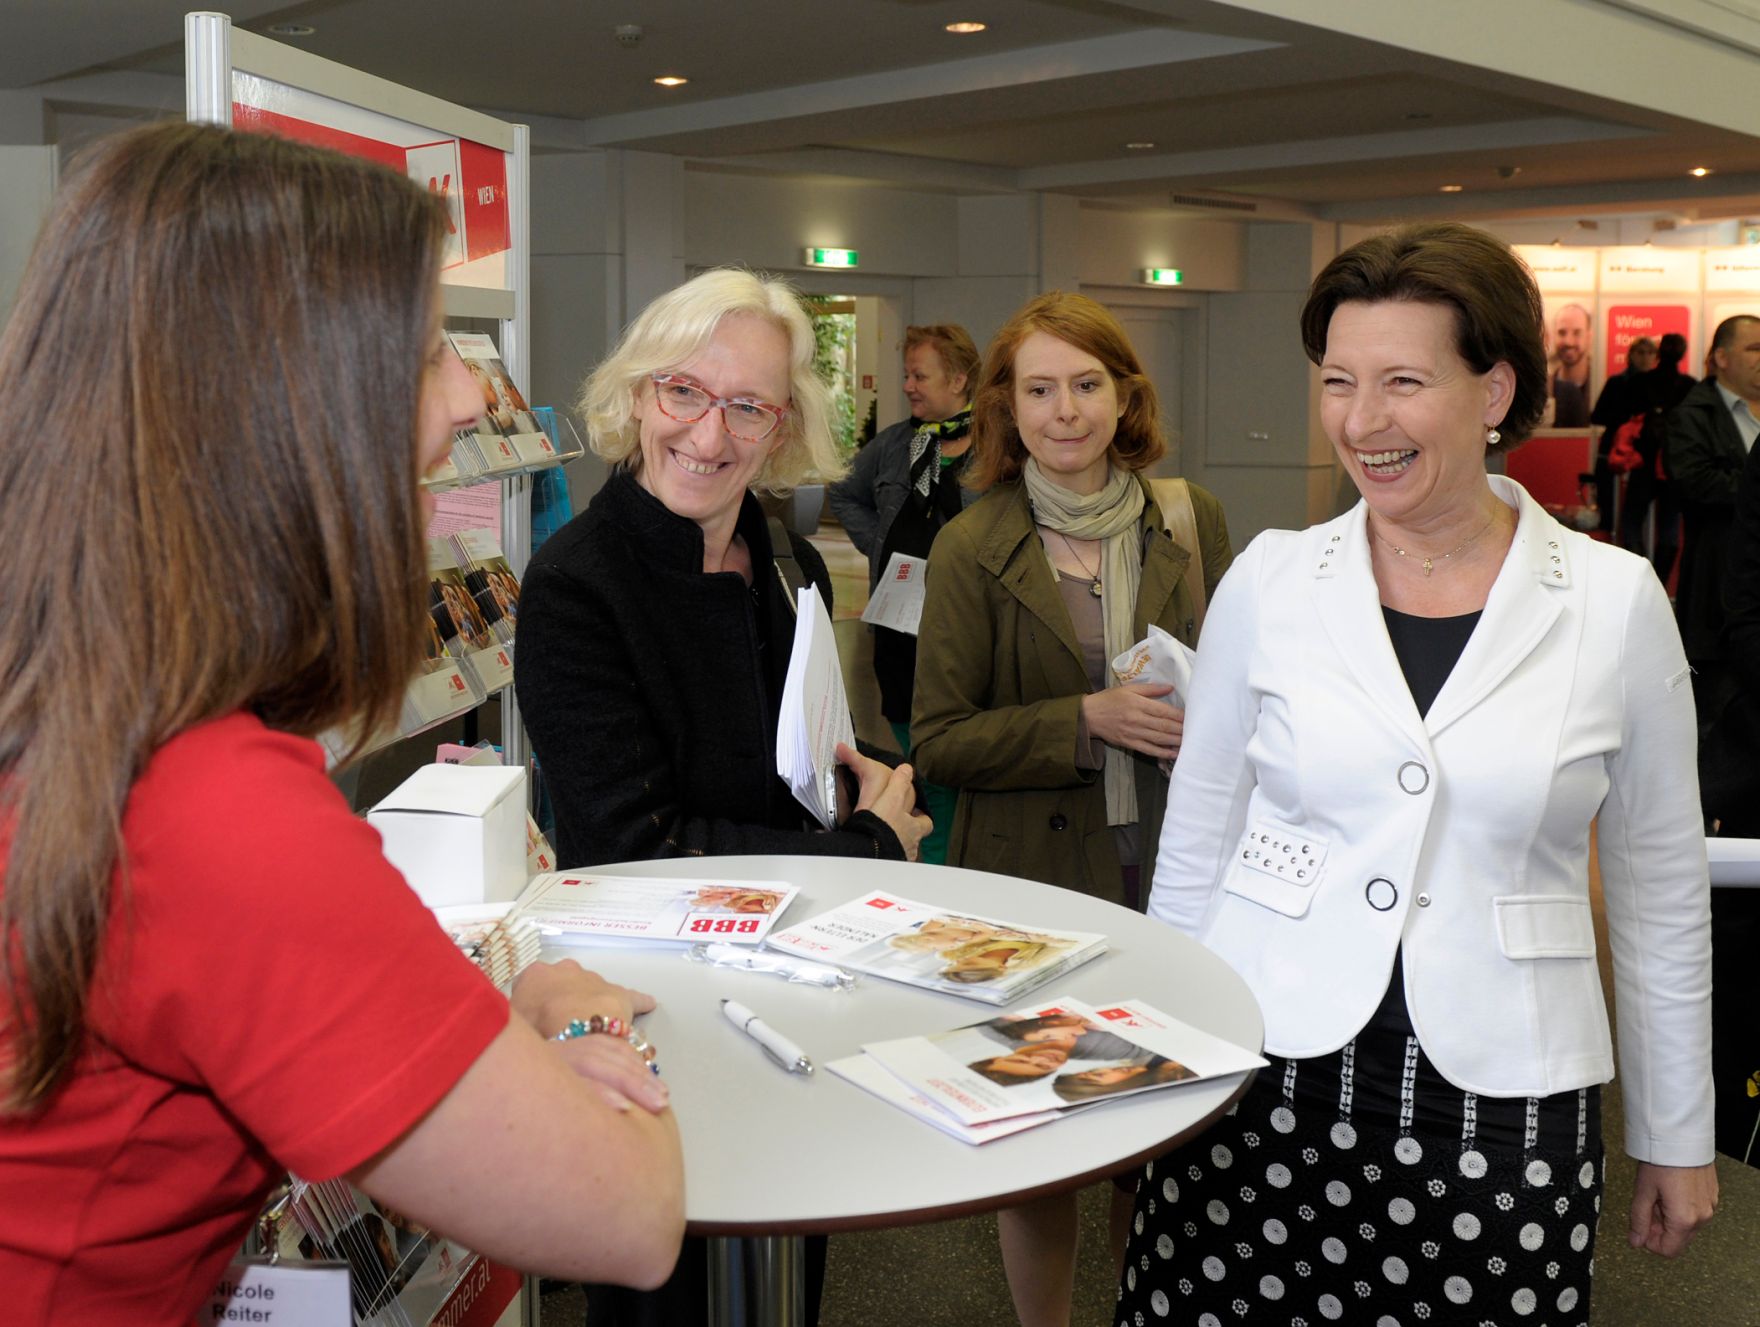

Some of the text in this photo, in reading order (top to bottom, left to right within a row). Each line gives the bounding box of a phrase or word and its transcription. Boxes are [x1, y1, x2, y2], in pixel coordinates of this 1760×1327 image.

[477, 185, 495, 206] WIEN
[1615, 315, 1653, 329] Wien
[690, 918, 760, 934] BBB
[213, 1281, 275, 1300] Nicole
[212, 1304, 273, 1322] Reiter
